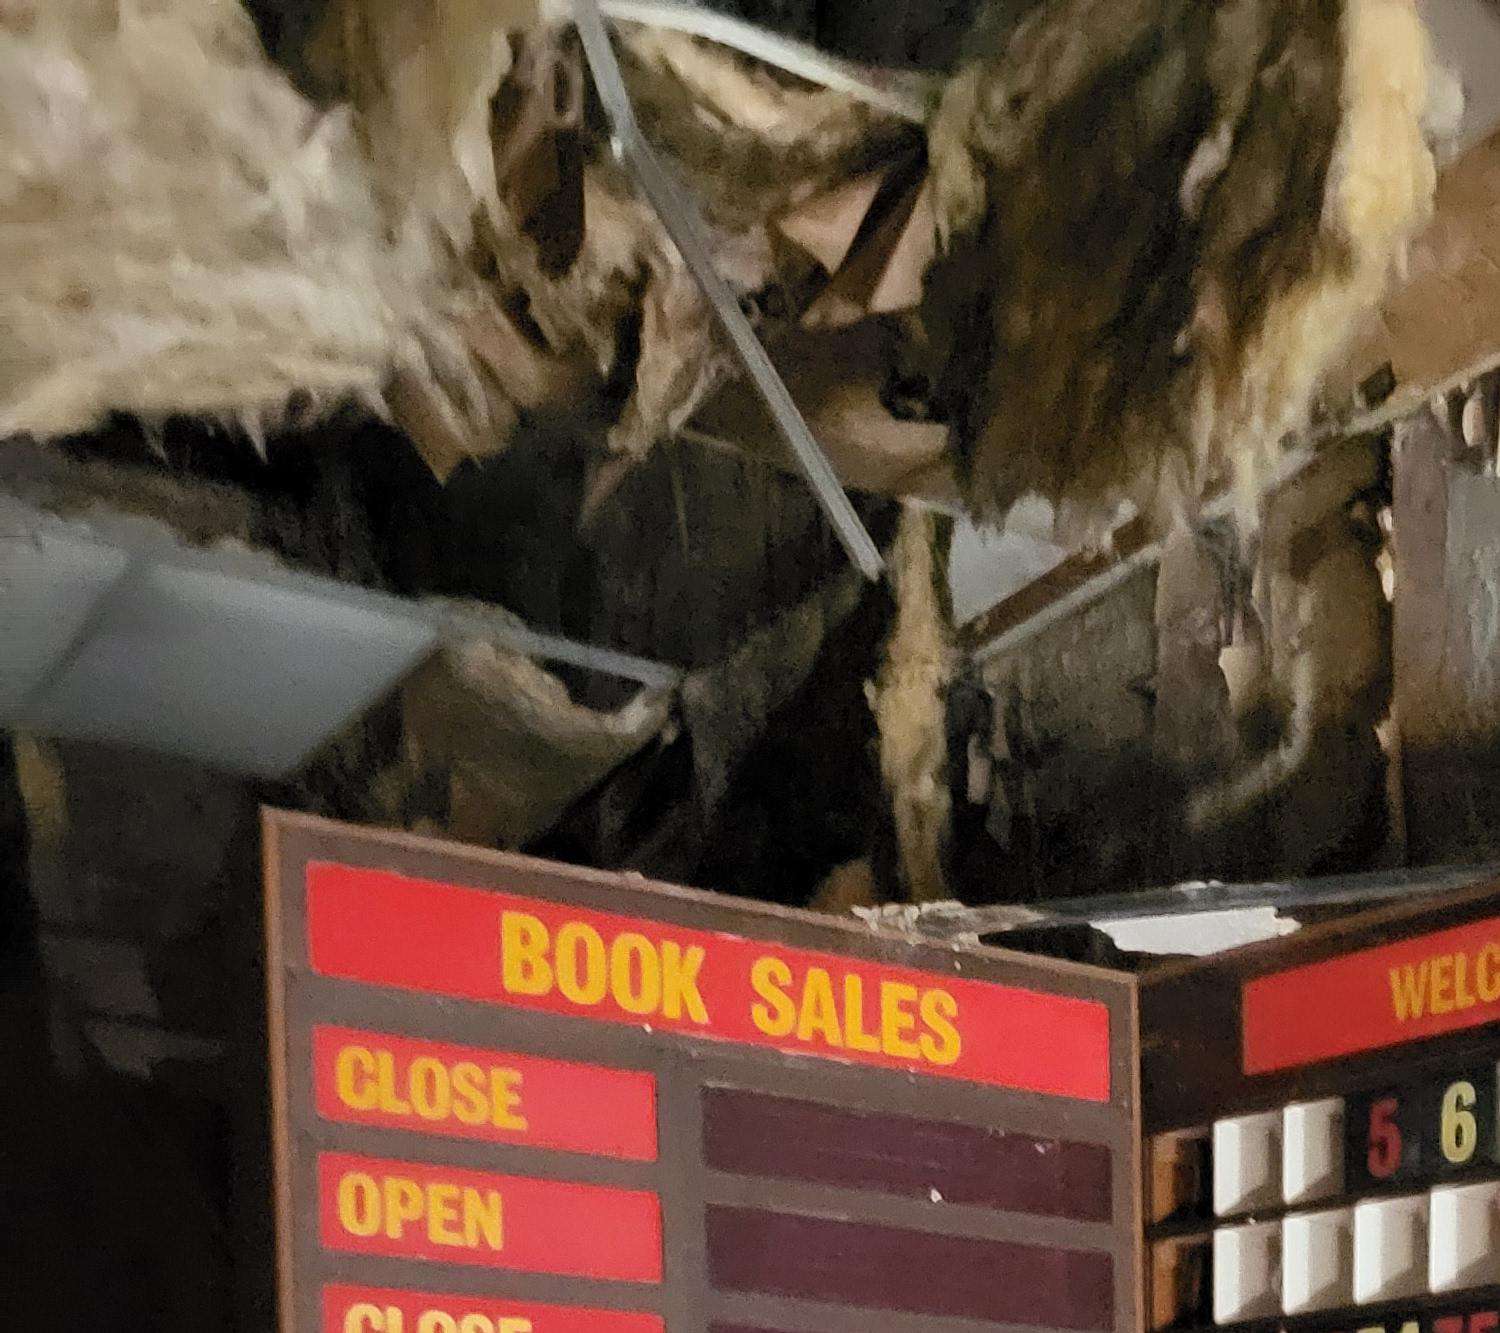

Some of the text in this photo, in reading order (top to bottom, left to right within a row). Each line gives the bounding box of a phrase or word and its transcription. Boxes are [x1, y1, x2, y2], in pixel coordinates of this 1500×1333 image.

[501, 911, 963, 1066] BOOK SALES
[336, 1045, 526, 1130] CLOSE
[1369, 1082, 1475, 1177] 5 6
[338, 1172, 503, 1250] OPEN
